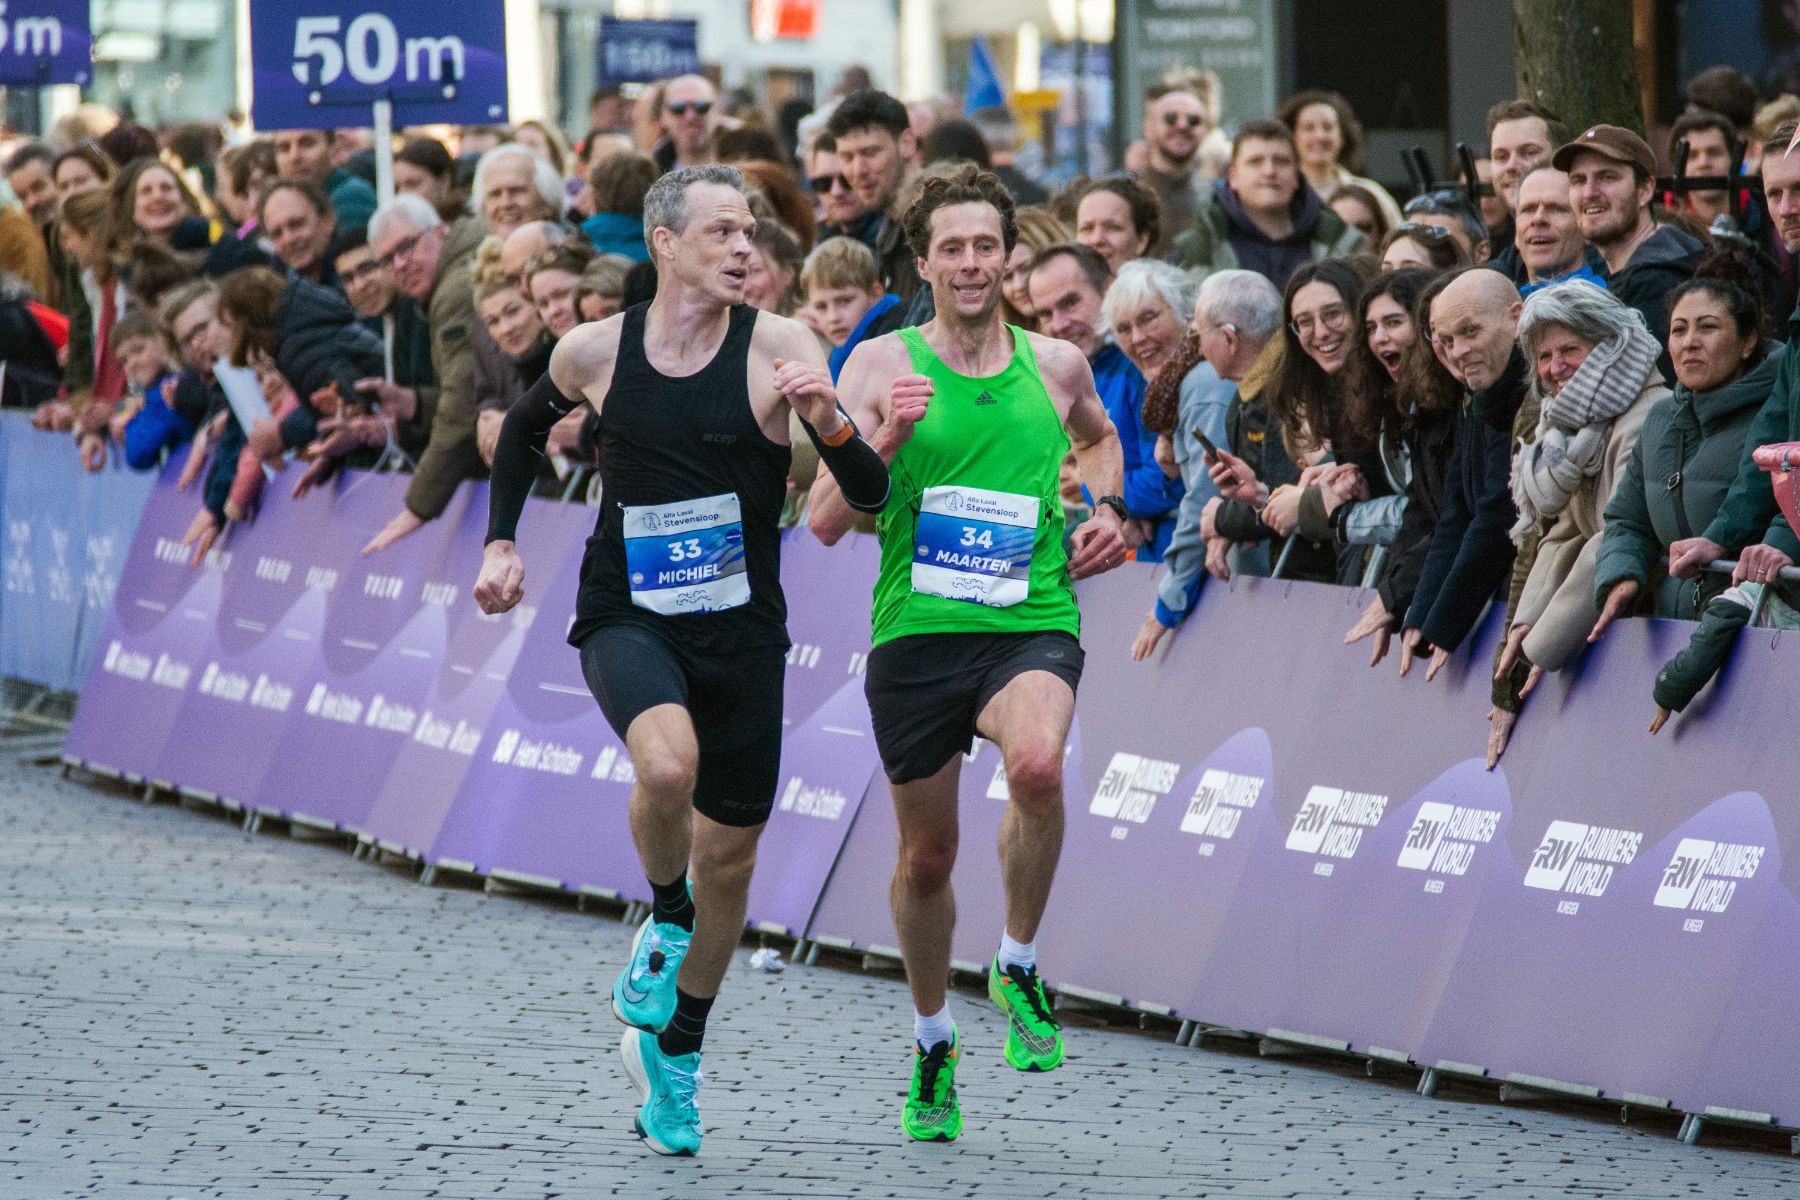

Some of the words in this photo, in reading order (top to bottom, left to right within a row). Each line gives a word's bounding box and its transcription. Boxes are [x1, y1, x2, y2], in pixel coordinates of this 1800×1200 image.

[0, 0, 61, 56] m
[664, 512, 720, 528] Stevensloop
[965, 503, 1019, 519] Stevensloop
[667, 538, 702, 562] 33
[959, 526, 993, 549] 34
[658, 563, 721, 585] MICHIEL
[935, 550, 1012, 573] MAARTEN
[1295, 802, 1335, 834] RW
[1334, 790, 1389, 827] RUNNERS
[1445, 806, 1501, 843] RUNNERS
[1320, 823, 1364, 859] WORLD
[1405, 818, 1446, 850] RW
[1579, 826, 1643, 864] RUNNERS
[1431, 840, 1476, 876] WORLD
[1533, 838, 1581, 871] RW
[1705, 842, 1766, 878] RUNNERS
[1564, 861, 1613, 897] WORLD
[1663, 855, 1706, 889] RW
[1691, 878, 1737, 913] WORLD
